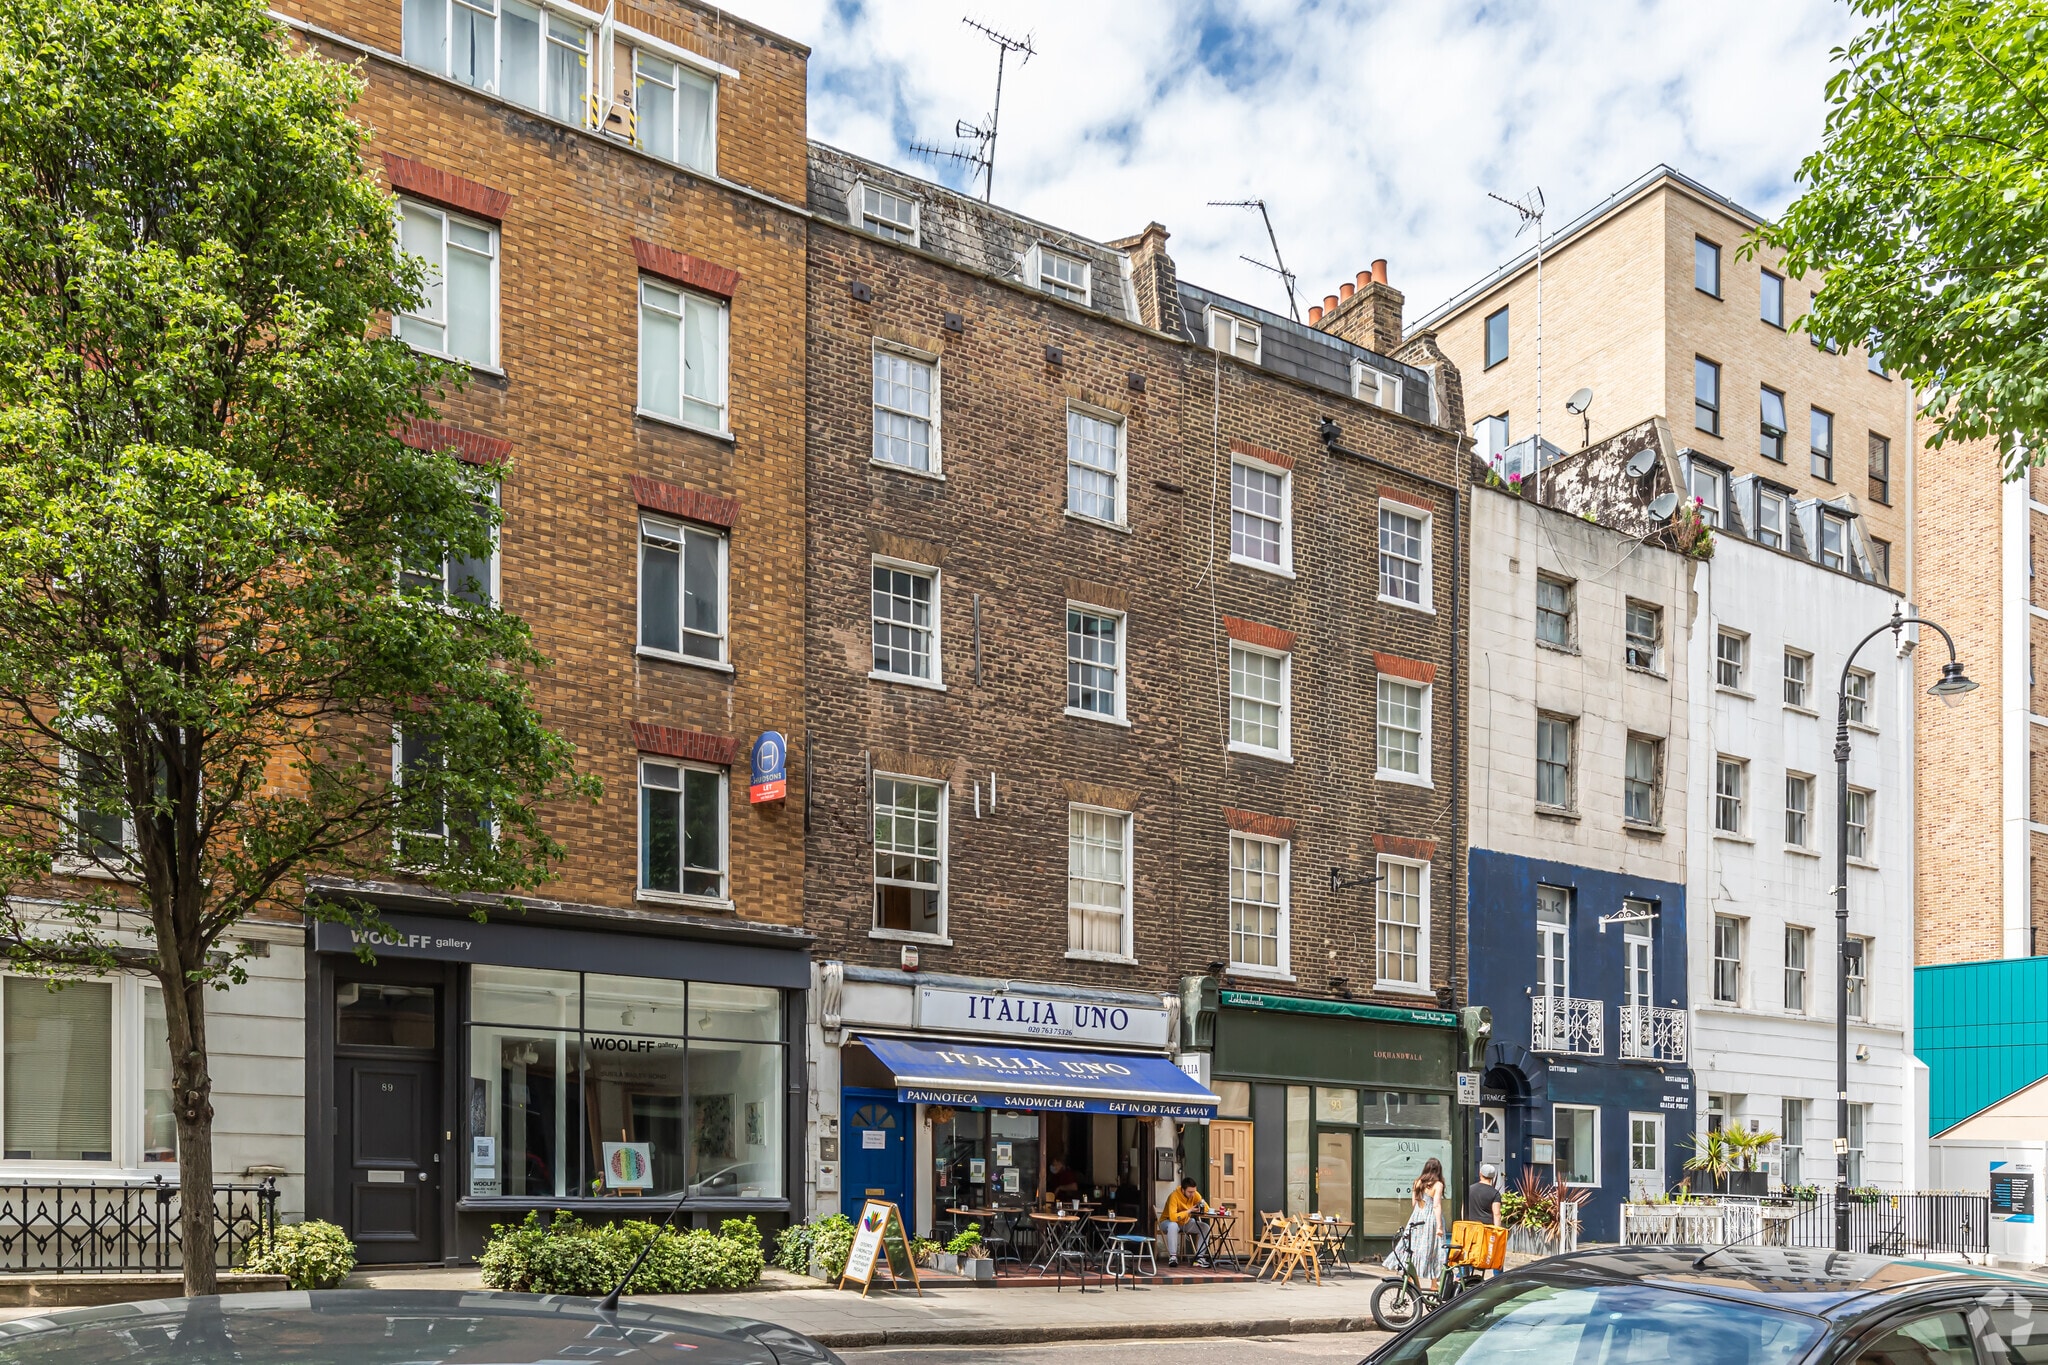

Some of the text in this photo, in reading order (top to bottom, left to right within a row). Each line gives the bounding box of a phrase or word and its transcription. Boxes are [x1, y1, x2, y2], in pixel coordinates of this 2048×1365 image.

[753, 773, 781, 784] HUDSONS
[351, 930, 472, 950] WOOLFF gallery
[968, 996, 1128, 1030] ITALIA UNO
[590, 1037, 655, 1053] WOOLFF
[1374, 1050, 1422, 1060] LOKHANDWALA
[936, 1052, 1131, 1076] ITALIA UNO
[382, 1083, 393, 1091] 89
[907, 1090, 1209, 1116] PANINOTECA SANDWICH BAR EAT IN OR TAKE AWAY
[1330, 1100, 1342, 1110] 93
[1835, 1140, 1846, 1152] H
